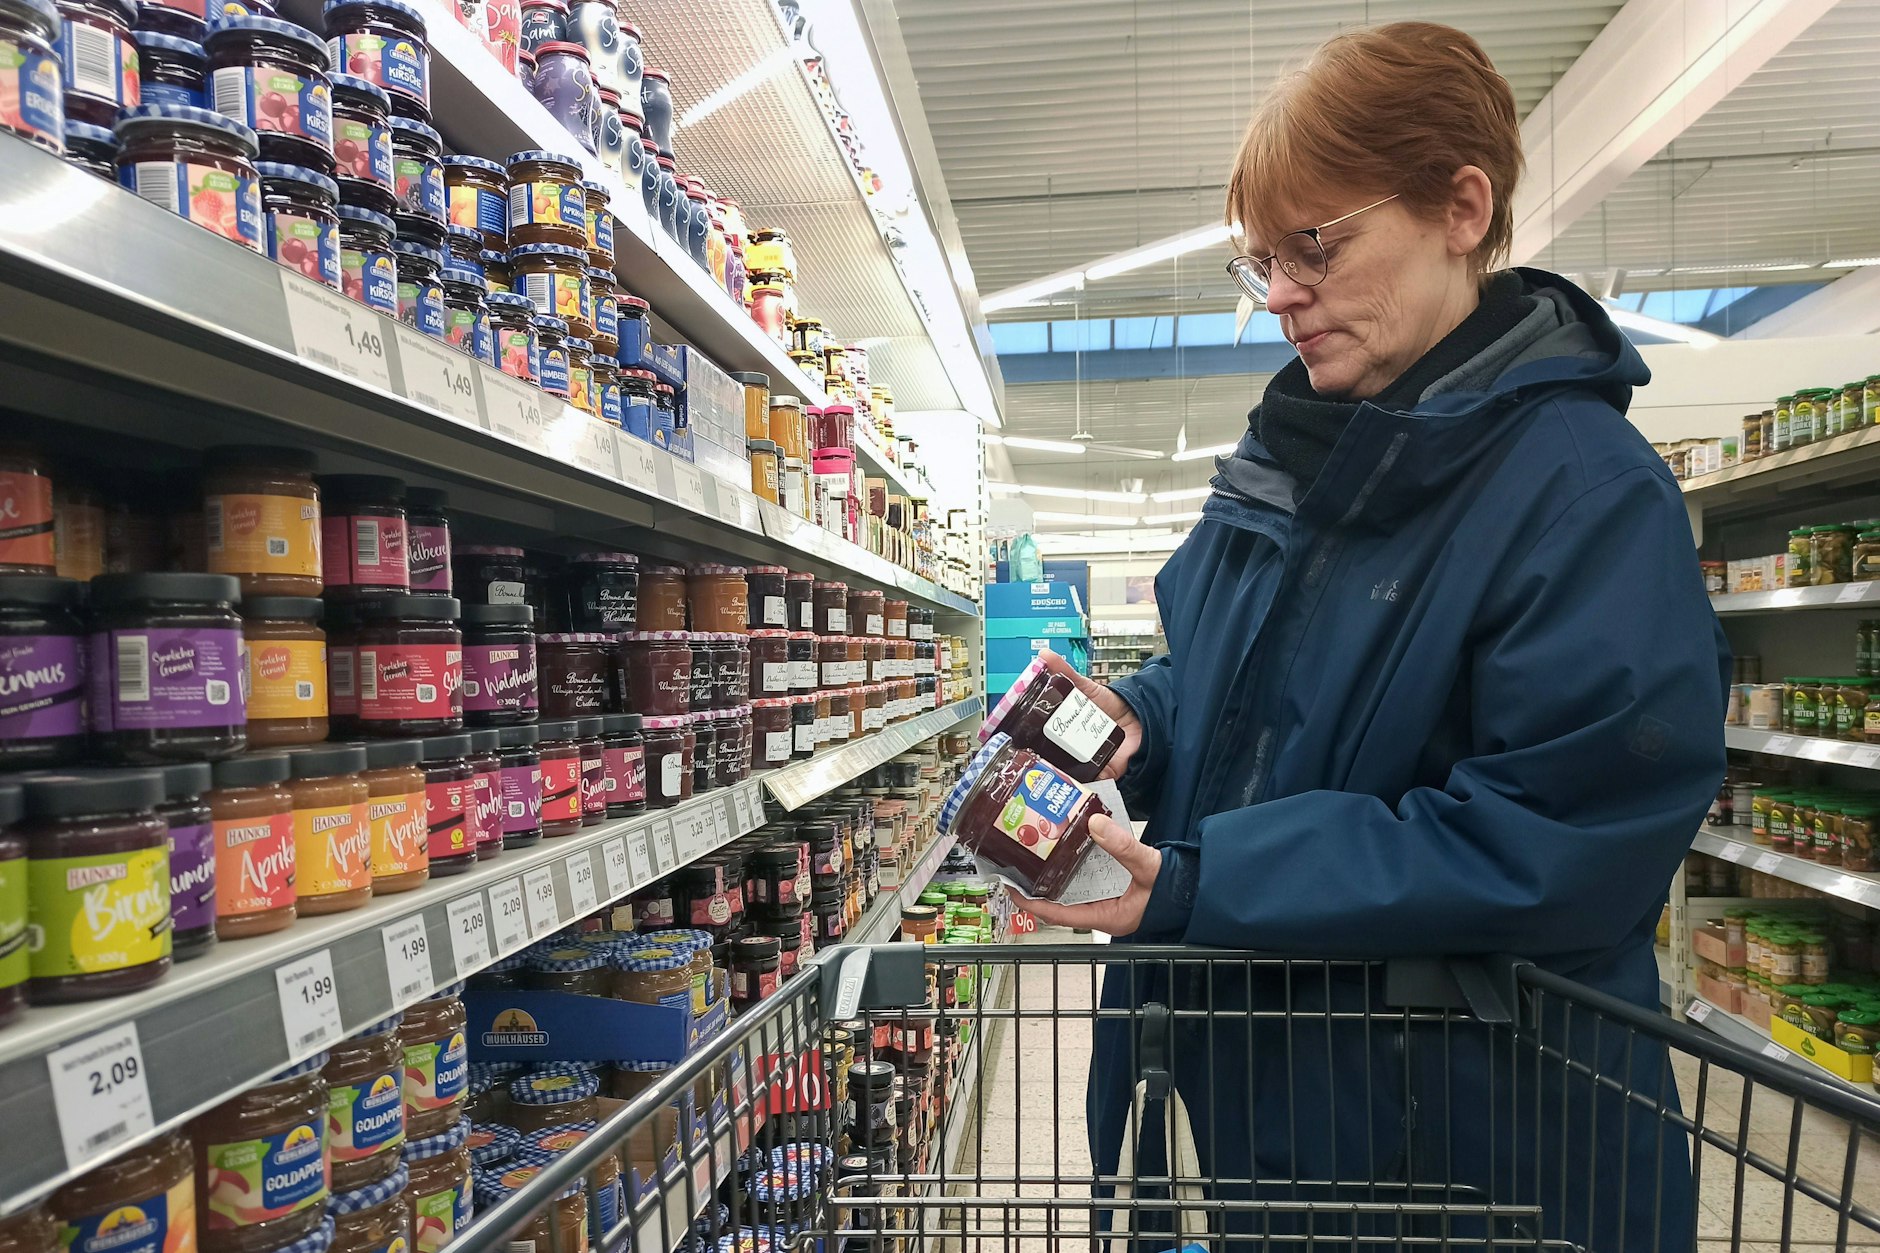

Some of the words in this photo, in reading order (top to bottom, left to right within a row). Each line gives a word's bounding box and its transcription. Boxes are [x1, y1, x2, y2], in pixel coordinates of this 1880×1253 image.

[521, 19, 560, 51] Samt
[345, 323, 382, 358] 1,49
[443, 368, 472, 397] 1,49
[517, 402, 541, 426] 1,49
[593, 433, 612, 455] 1,49
[640, 455, 654, 474] 1,49
[1031, 598, 1067, 606] EDUSCHO
[489, 650, 519, 664] HAINICH
[1053, 708, 1080, 737] Bonne
[1047, 782, 1074, 814] BANANE
[371, 801, 407, 820] HAINICH
[1009, 805, 1025, 826] LECKER
[313, 813, 352, 834] HAINICH
[691, 821, 704, 838] 3,29
[226, 825, 271, 848] HAINICH
[661, 833, 671, 847] 1,99
[612, 852, 625, 867] 1,99
[635, 844, 647, 857] 1,99
[67, 864, 127, 890] HAINICH
[577, 866, 591, 884] 2,09
[536, 883, 553, 902] 1,99
[84, 881, 163, 942] Birne
[502, 896, 521, 917] 2,09
[463, 913, 484, 934] 2,09
[401, 937, 426, 961] 1,99
[301, 976, 332, 1005] 1,99
[486, 1033, 545, 1045] MÜHLHÄUSER
[88, 1056, 138, 1096] 2,09
